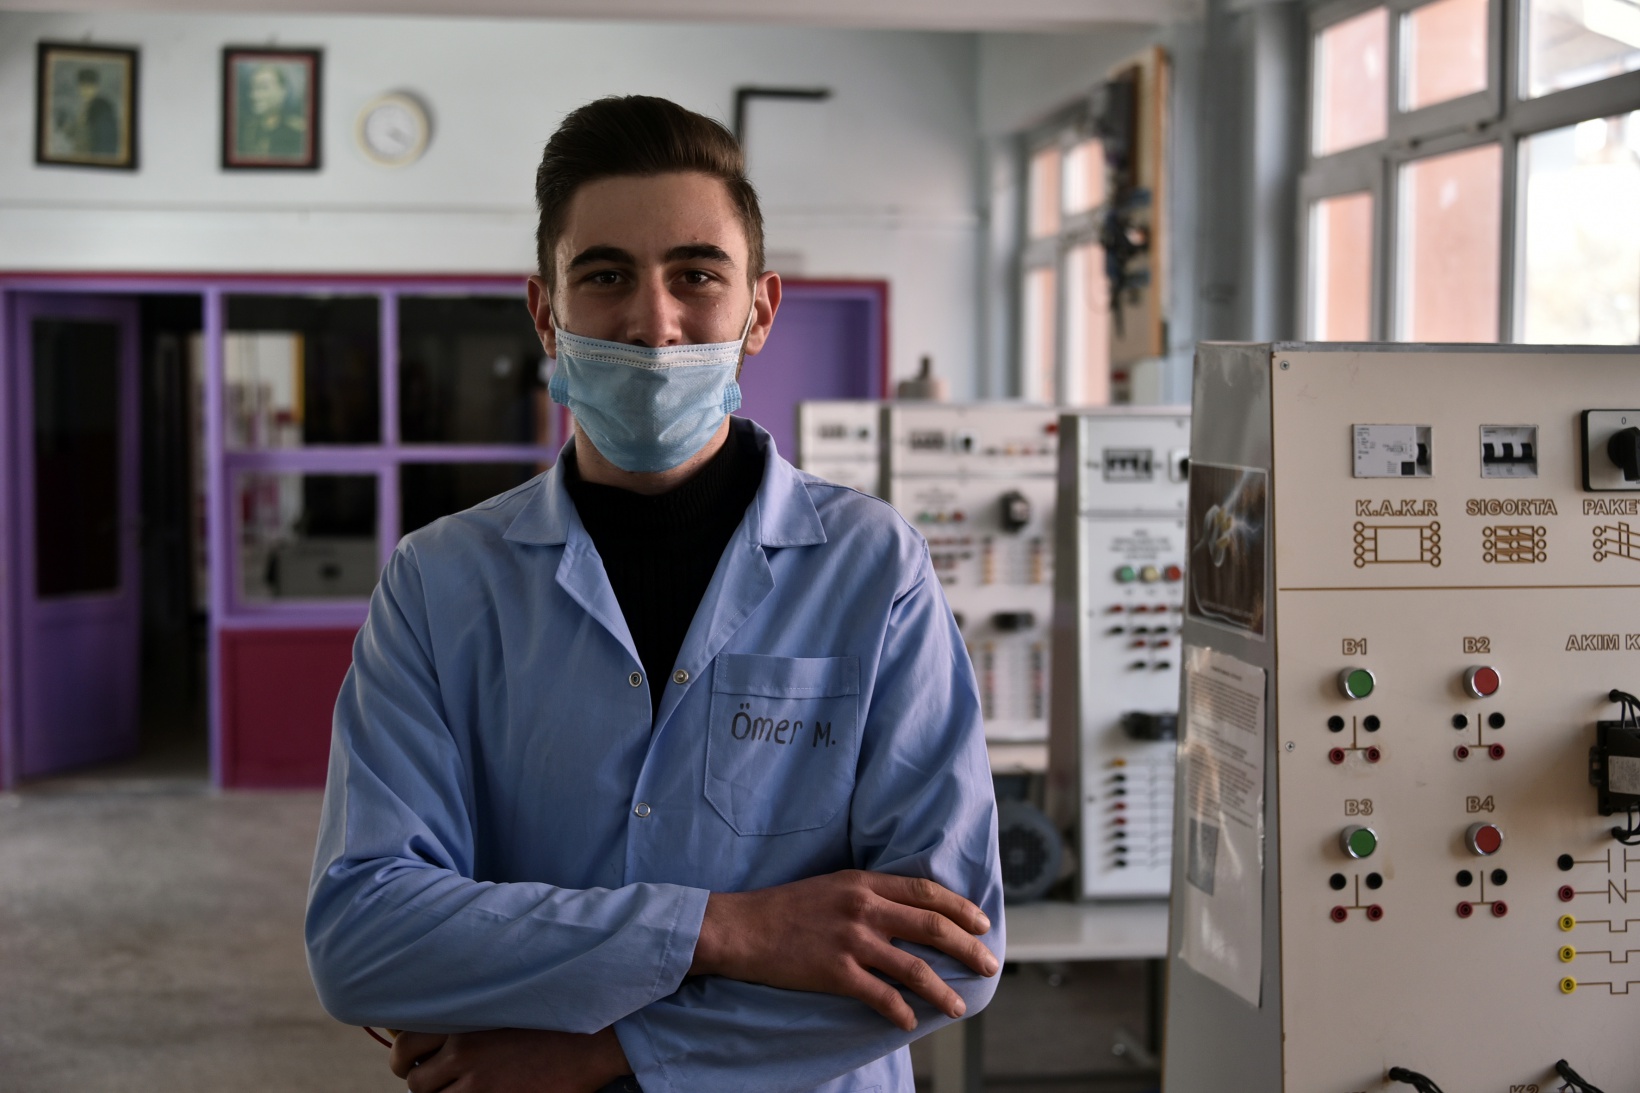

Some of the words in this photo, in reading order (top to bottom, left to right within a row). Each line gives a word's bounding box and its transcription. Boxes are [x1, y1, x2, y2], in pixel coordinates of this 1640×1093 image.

[1355, 499, 1438, 516] K.A.K.R
[1465, 499, 1558, 516] SIGORTA
[1582, 498, 1640, 516] PAKE
[1342, 638, 1367, 655] B1
[1463, 636, 1491, 654] B2
[1565, 633, 1620, 651] AKIM
[730, 702, 803, 745] Ömer
[812, 721, 837, 748] M.
[1344, 798, 1373, 816] B3
[1466, 795, 1495, 813] B4
